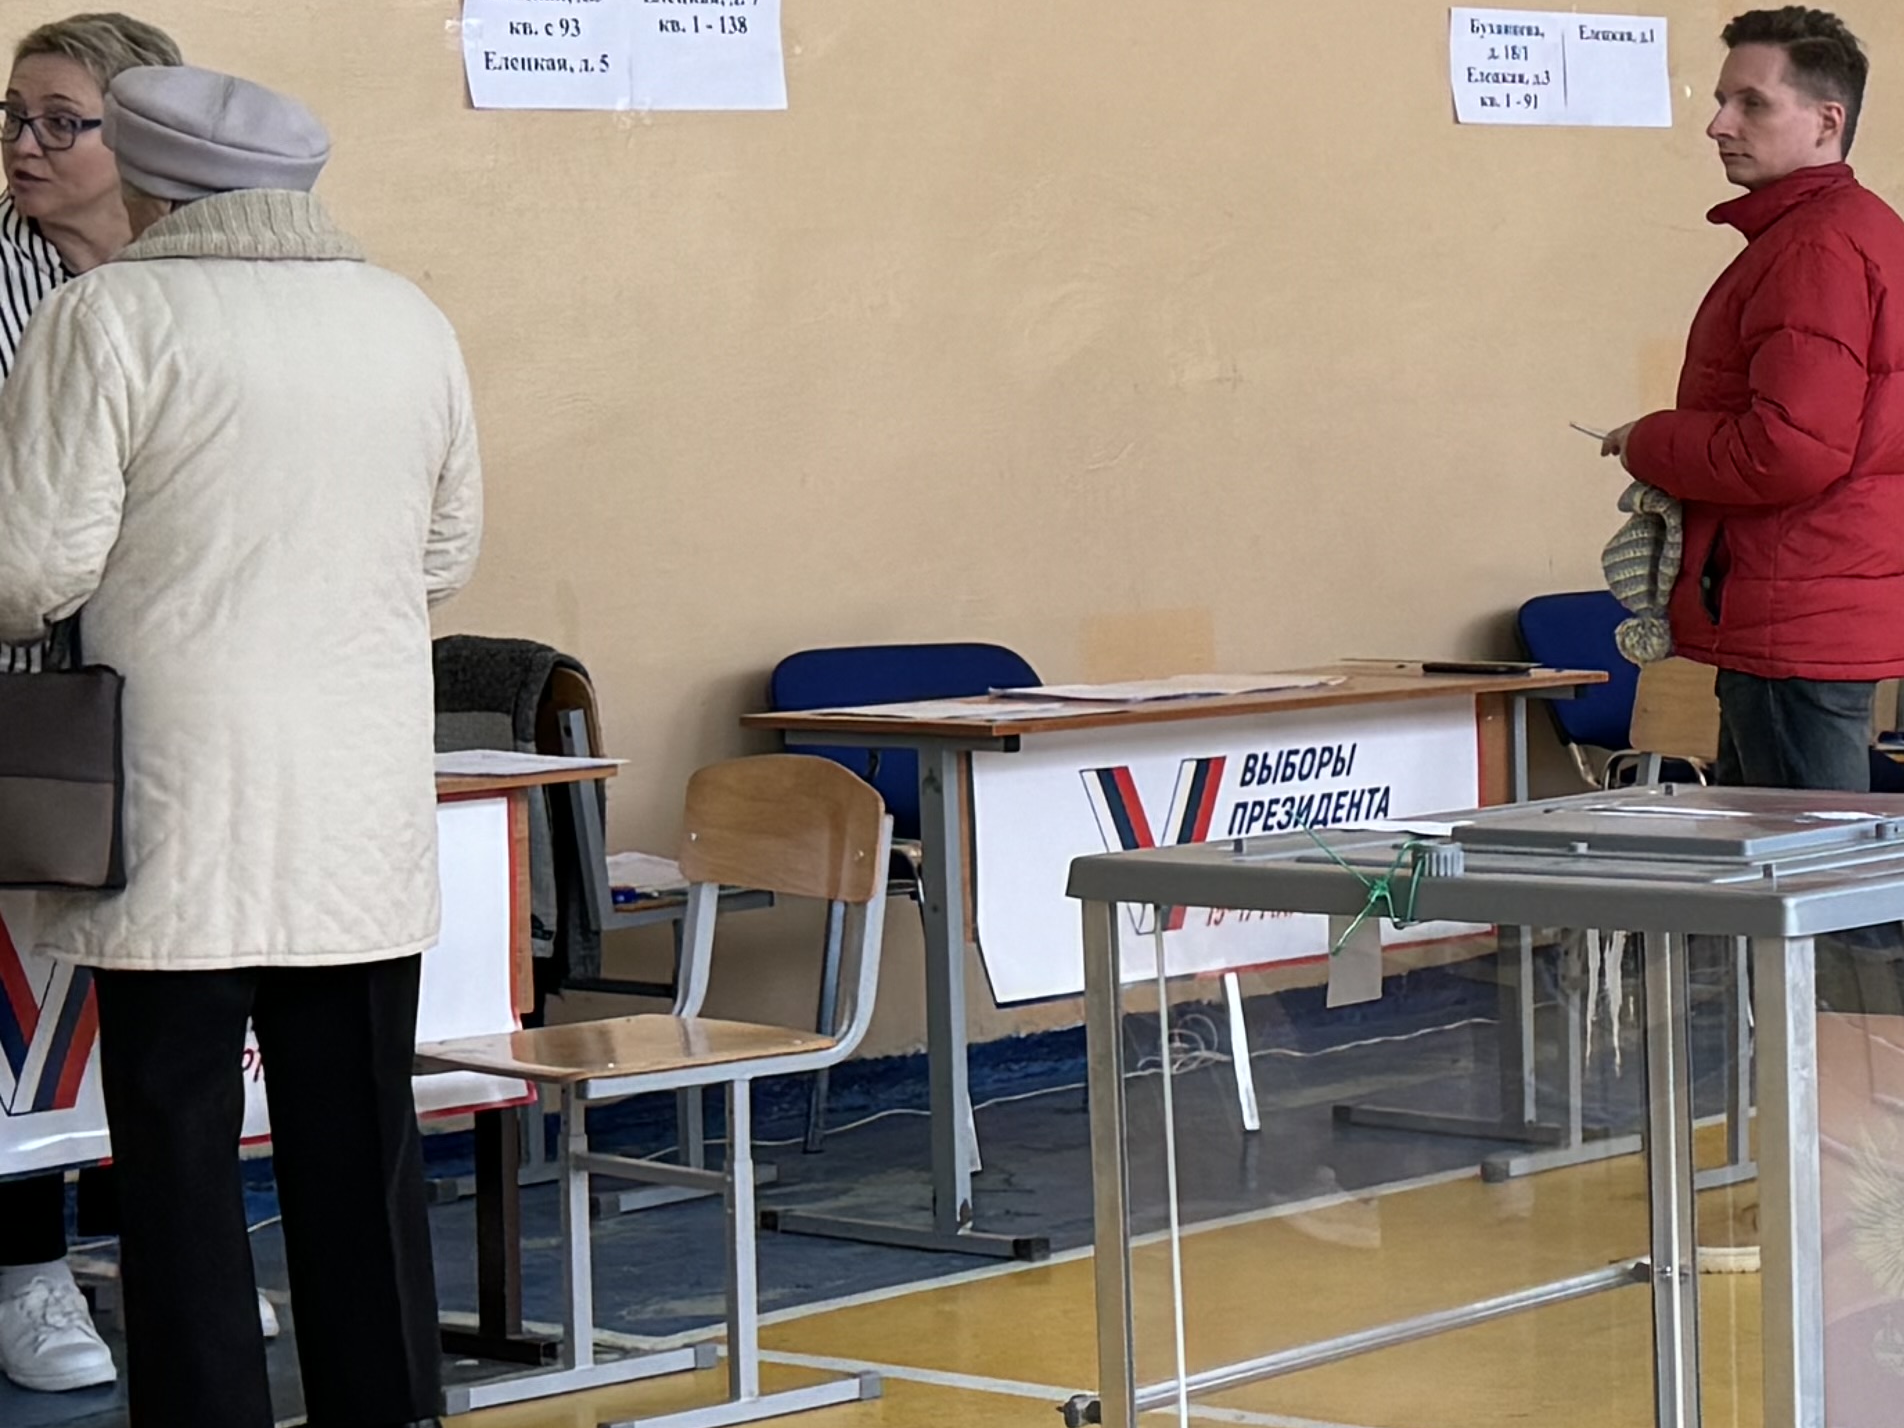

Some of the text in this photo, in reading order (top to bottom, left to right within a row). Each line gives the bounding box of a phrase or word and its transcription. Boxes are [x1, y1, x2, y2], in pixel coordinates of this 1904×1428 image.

[510, 19, 580, 37] кв. с 93
[659, 20, 685, 32] кв.
[720, 16, 747, 34] 138
[485, 52, 574, 72] Елецкая,
[600, 54, 608, 72] 5
[1524, 94, 1537, 109] 91
[1240, 743, 1356, 787] ВЫБОРЫ
[1229, 786, 1390, 836] ПРЕЗИДЕНТА
